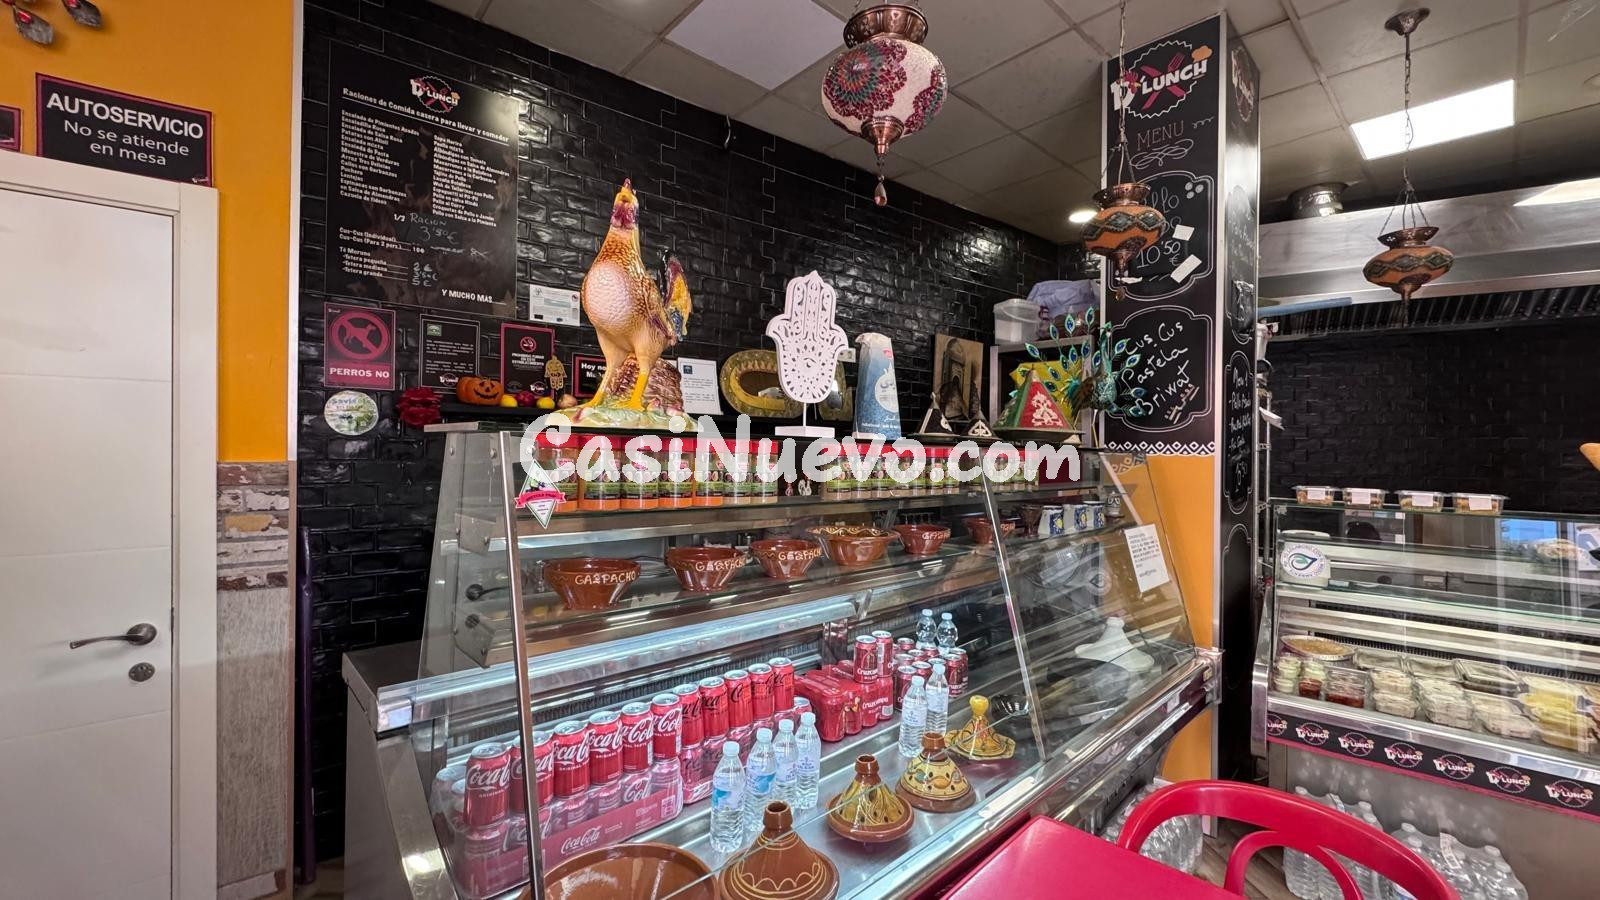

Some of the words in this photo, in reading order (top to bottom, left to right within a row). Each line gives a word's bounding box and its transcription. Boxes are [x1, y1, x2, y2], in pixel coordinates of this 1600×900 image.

[46, 92, 204, 139] AUTOSERVICIO
[343, 87, 377, 104] Raciones
[378, 99, 387, 107] de
[388, 101, 415, 116] Comida
[416, 110, 439, 121] casera
[440, 117, 456, 127] para
[457, 121, 475, 133] llevar
[63, 119, 92, 137] No
[97, 127, 118, 142] se
[122, 131, 190, 156] atiende
[1137, 120, 1185, 151] MENU
[89, 142, 114, 156] en
[119, 146, 167, 166] mesa
[441, 289, 448, 297] Y
[448, 290, 476, 300] MUCHO
[329, 367, 372, 378] PERROS
[375, 371, 390, 379] NO
[581, 362, 596, 371] Hoy
[1121, 347, 1189, 391] Pastela
